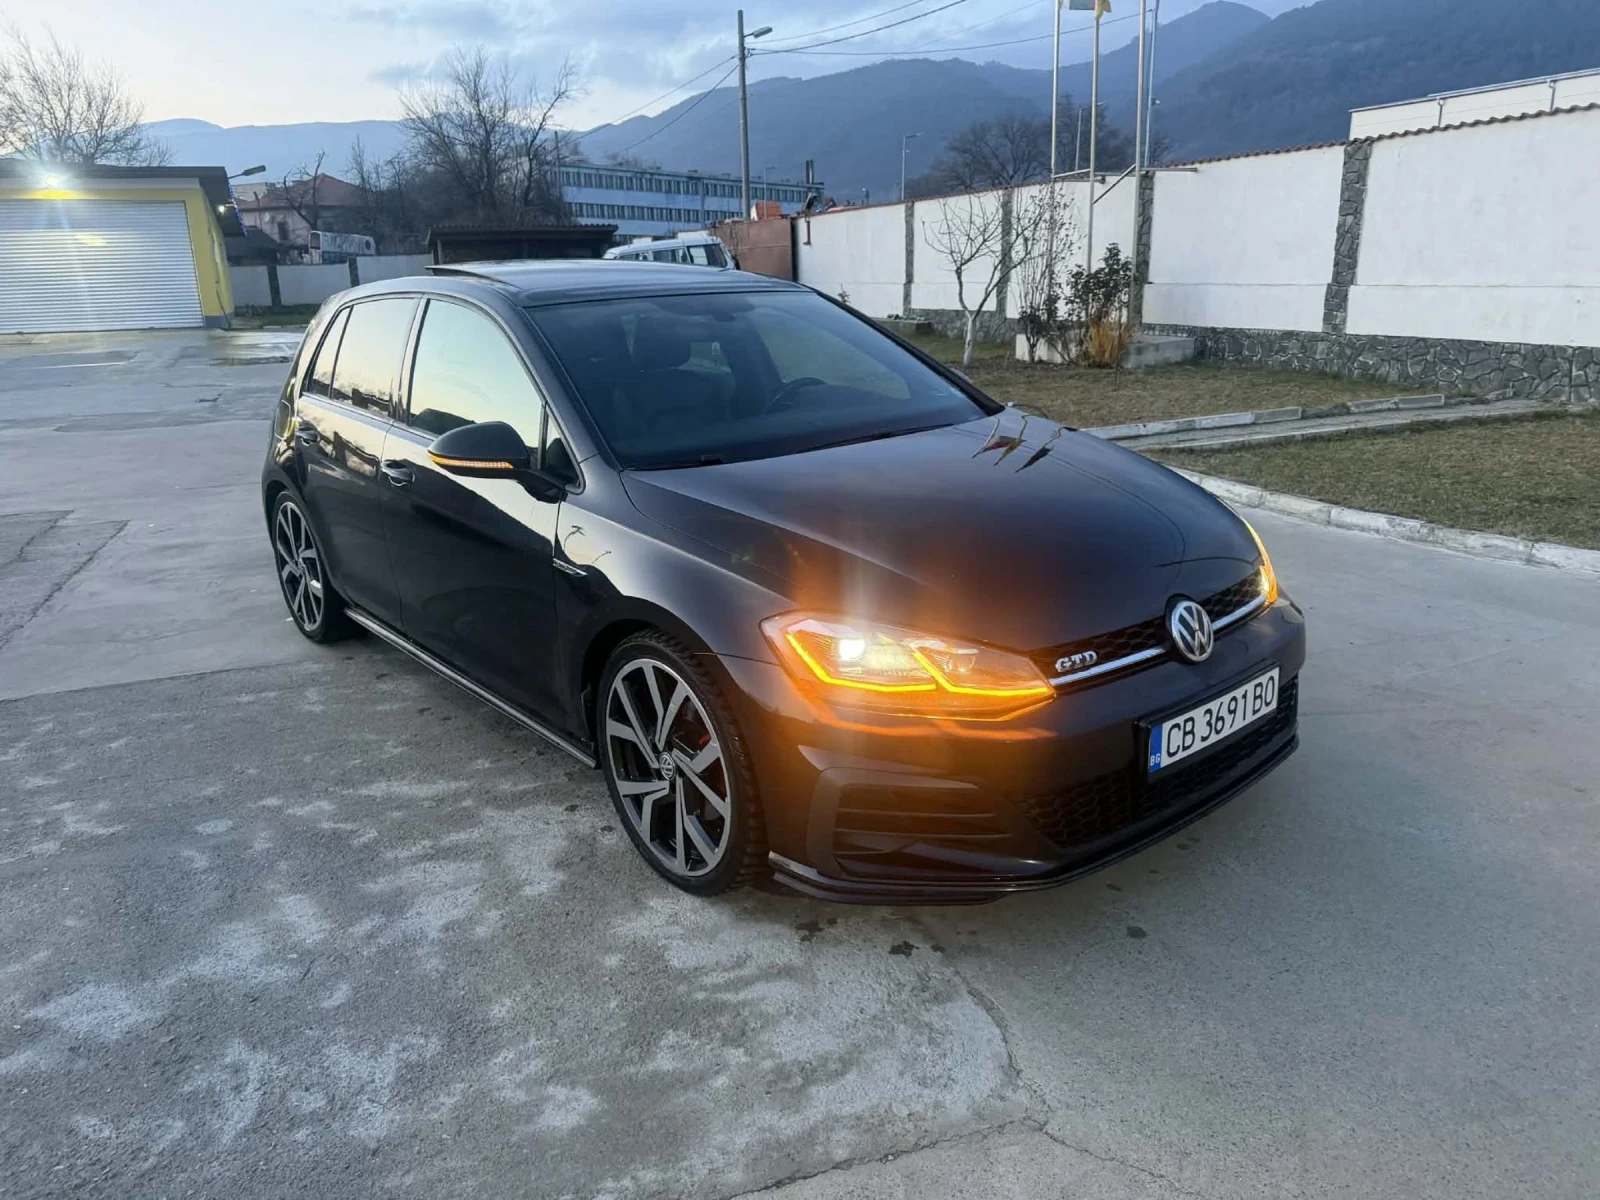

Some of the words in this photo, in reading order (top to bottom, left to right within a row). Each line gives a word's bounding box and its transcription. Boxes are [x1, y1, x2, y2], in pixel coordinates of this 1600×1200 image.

[1055, 651, 1097, 672] GTD
[1167, 717, 1195, 757] CB
[1201, 689, 1248, 742] 3691
[1252, 676, 1274, 716] BO
[1150, 753, 1160, 766] BG
